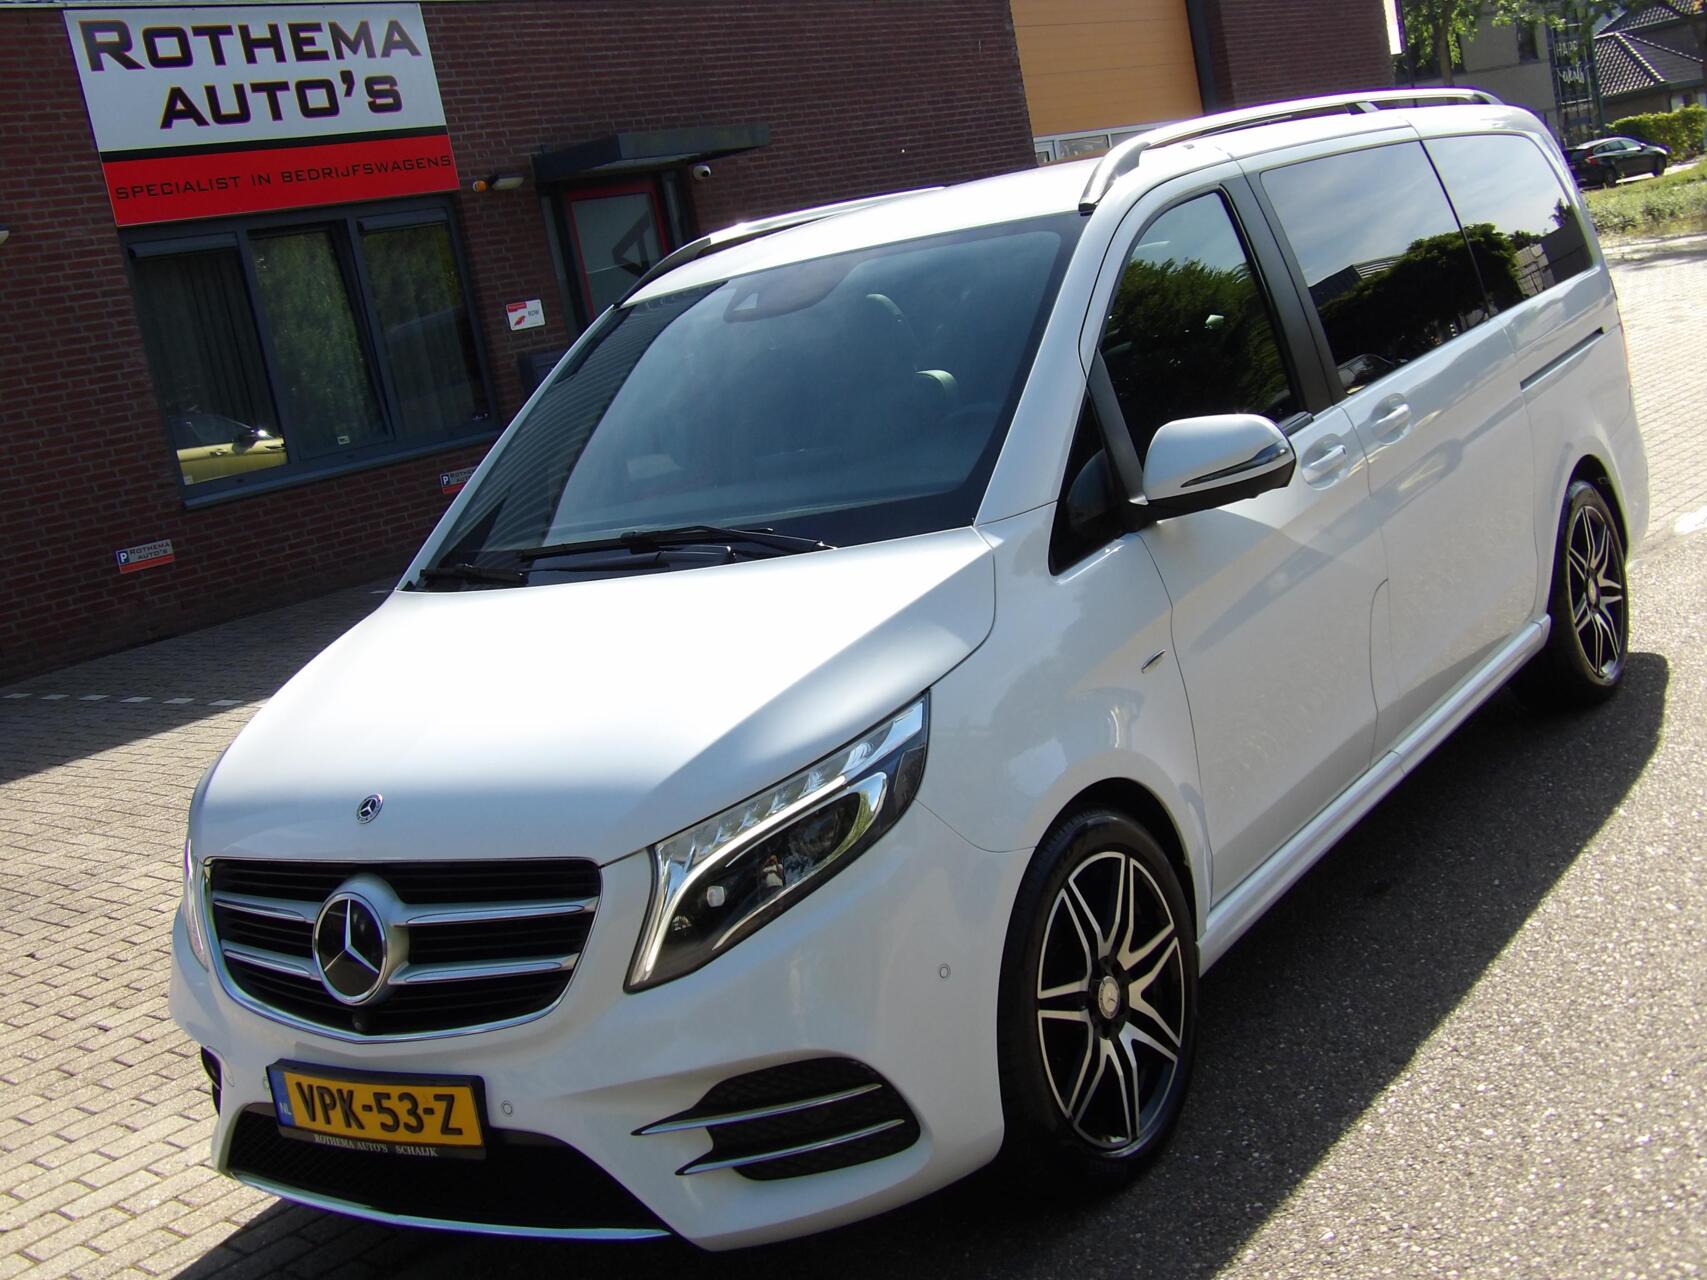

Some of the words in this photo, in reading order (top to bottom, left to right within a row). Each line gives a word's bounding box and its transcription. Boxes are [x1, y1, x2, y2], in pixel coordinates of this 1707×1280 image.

[78, 19, 422, 72] ROTHEMA
[160, 69, 403, 130] AUTO'S
[115, 175, 241, 201] SPECIALIST
[251, 173, 272, 187] IN
[281, 154, 452, 184] BEDRIJFSWAGENS
[119, 552, 128, 563] P
[129, 542, 170, 556] ROTHEMA
[138, 548, 168, 560] AUTO'S
[279, 1101, 292, 1116] NL
[295, 1081, 463, 1136] VPK-53-Z
[313, 1133, 355, 1149] ROTHEMA
[357, 1141, 389, 1153] AUTO'S
